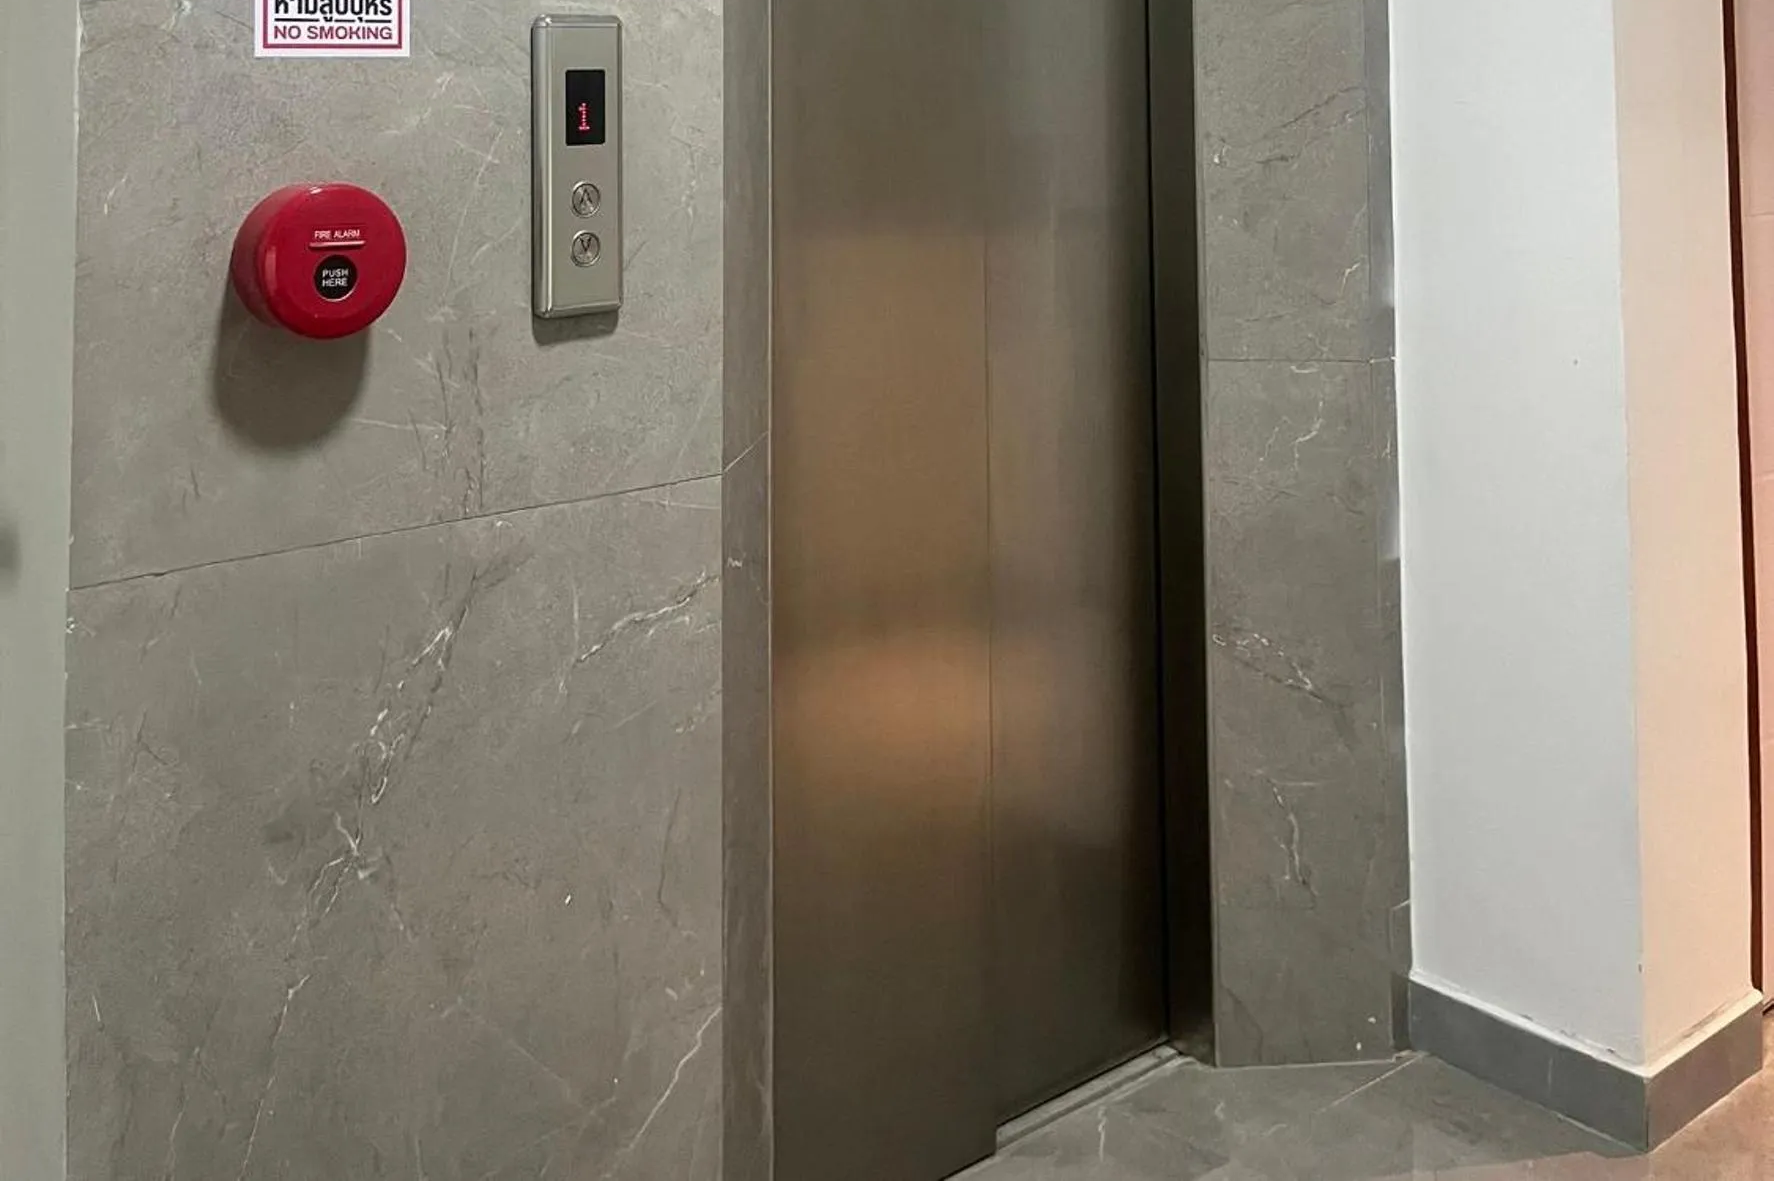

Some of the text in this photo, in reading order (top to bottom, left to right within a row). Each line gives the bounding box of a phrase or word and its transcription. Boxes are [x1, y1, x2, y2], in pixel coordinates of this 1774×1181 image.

[274, 25, 393, 40] NO SMOKING
[578, 102, 591, 131] 1
[314, 229, 360, 239] FIRE ALARM
[322, 269, 349, 278] PUSH
[322, 278, 348, 287] HERE
